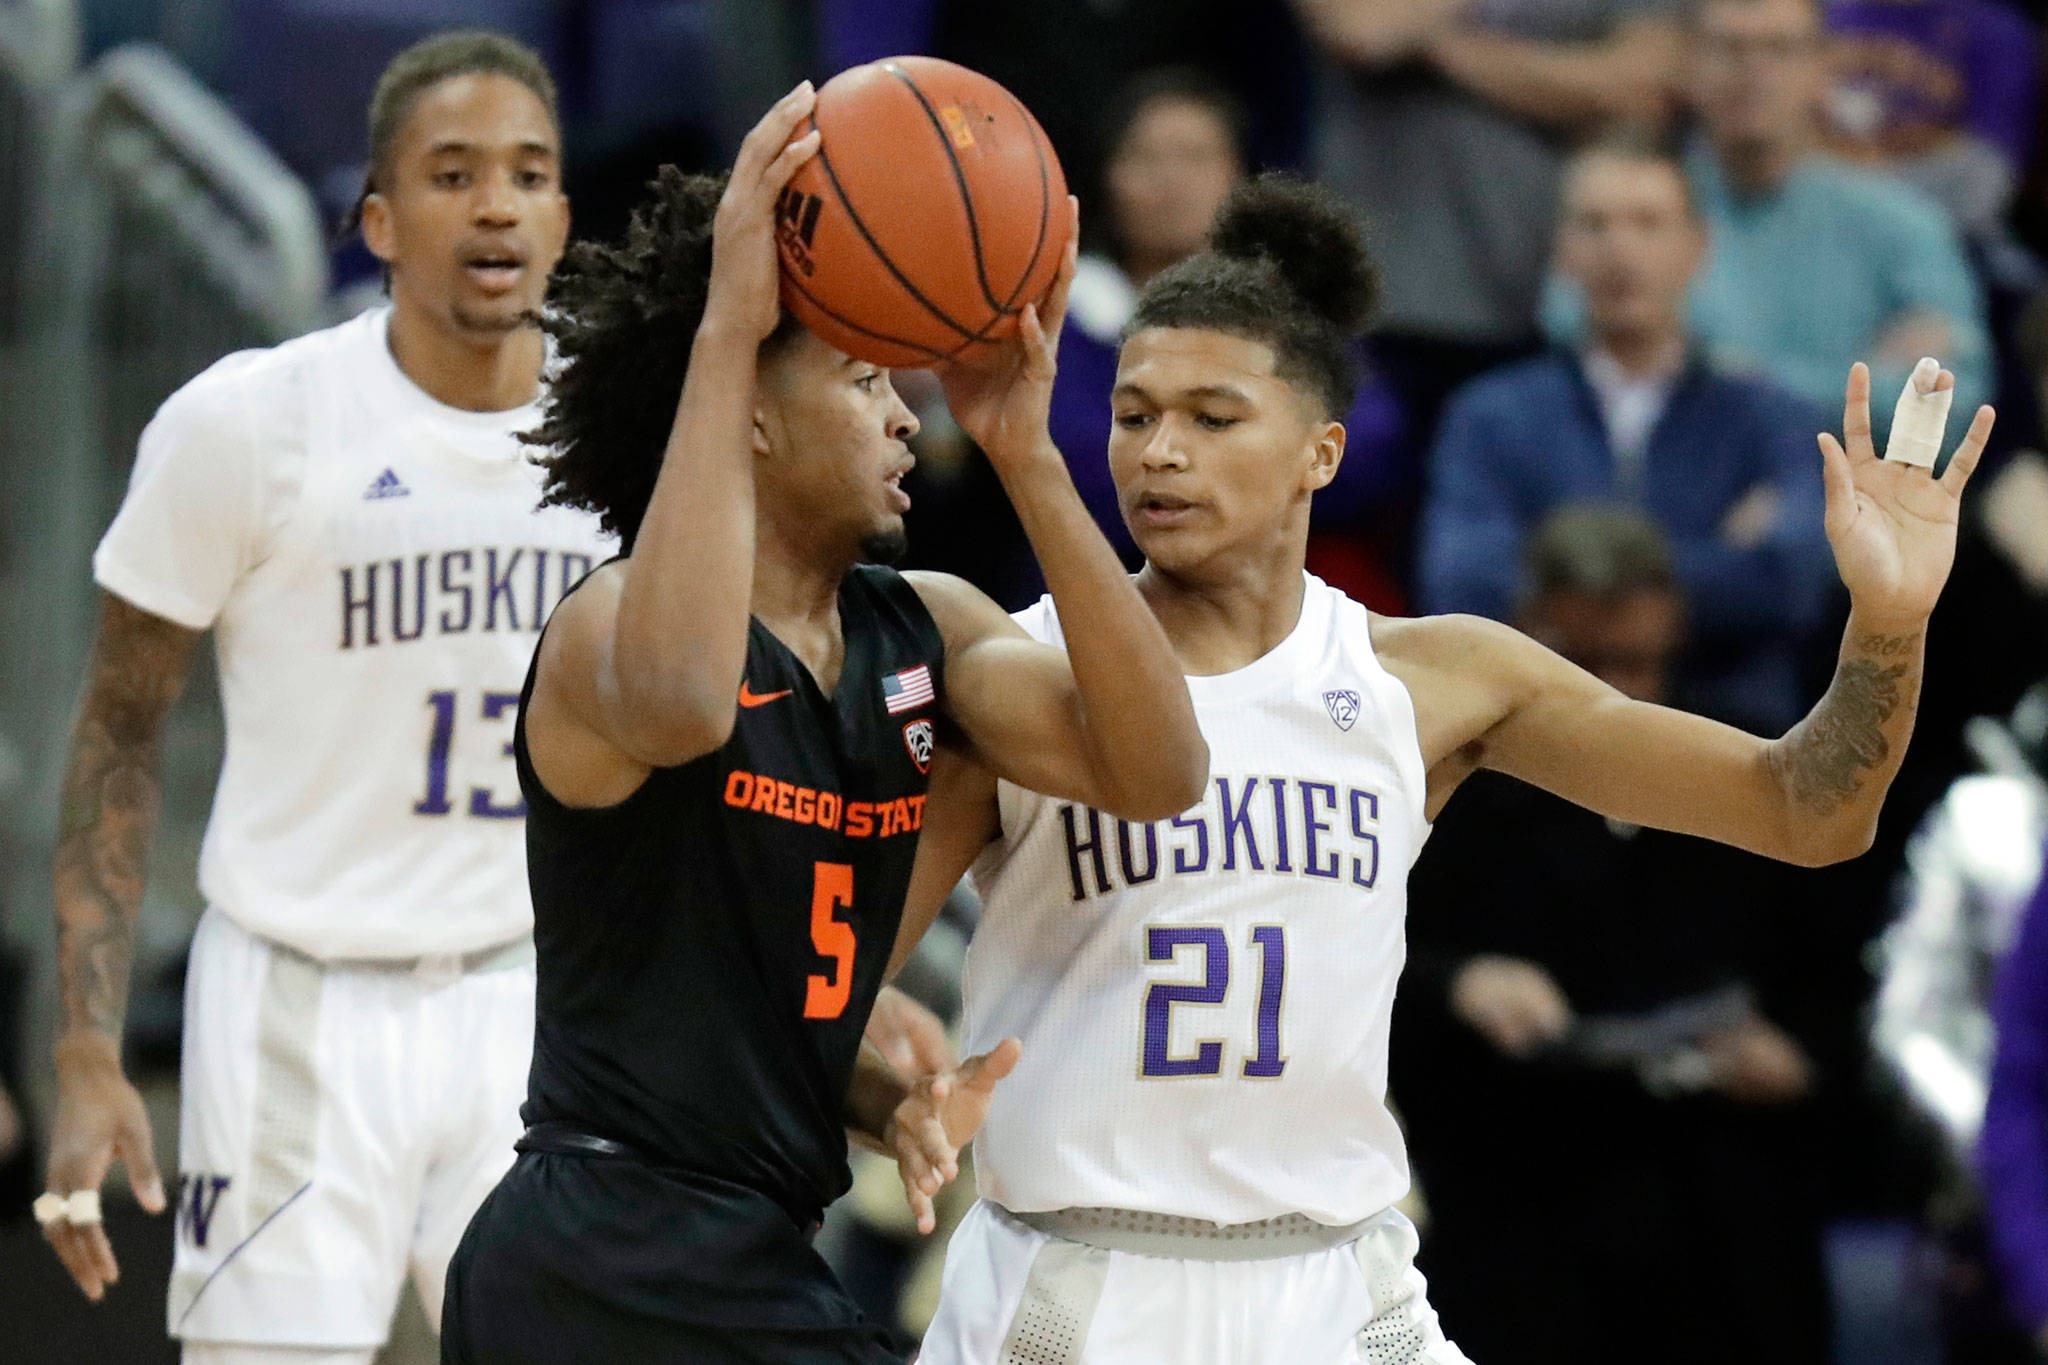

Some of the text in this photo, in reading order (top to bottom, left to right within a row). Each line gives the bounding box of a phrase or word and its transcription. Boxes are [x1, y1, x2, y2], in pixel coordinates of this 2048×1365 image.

[1325, 690, 1358, 711] PAC
[1335, 705, 1353, 721] 12
[1060, 776, 1380, 902] HUSKIES
[803, 861, 857, 1019] 5
[1138, 922, 1289, 1080] 21
